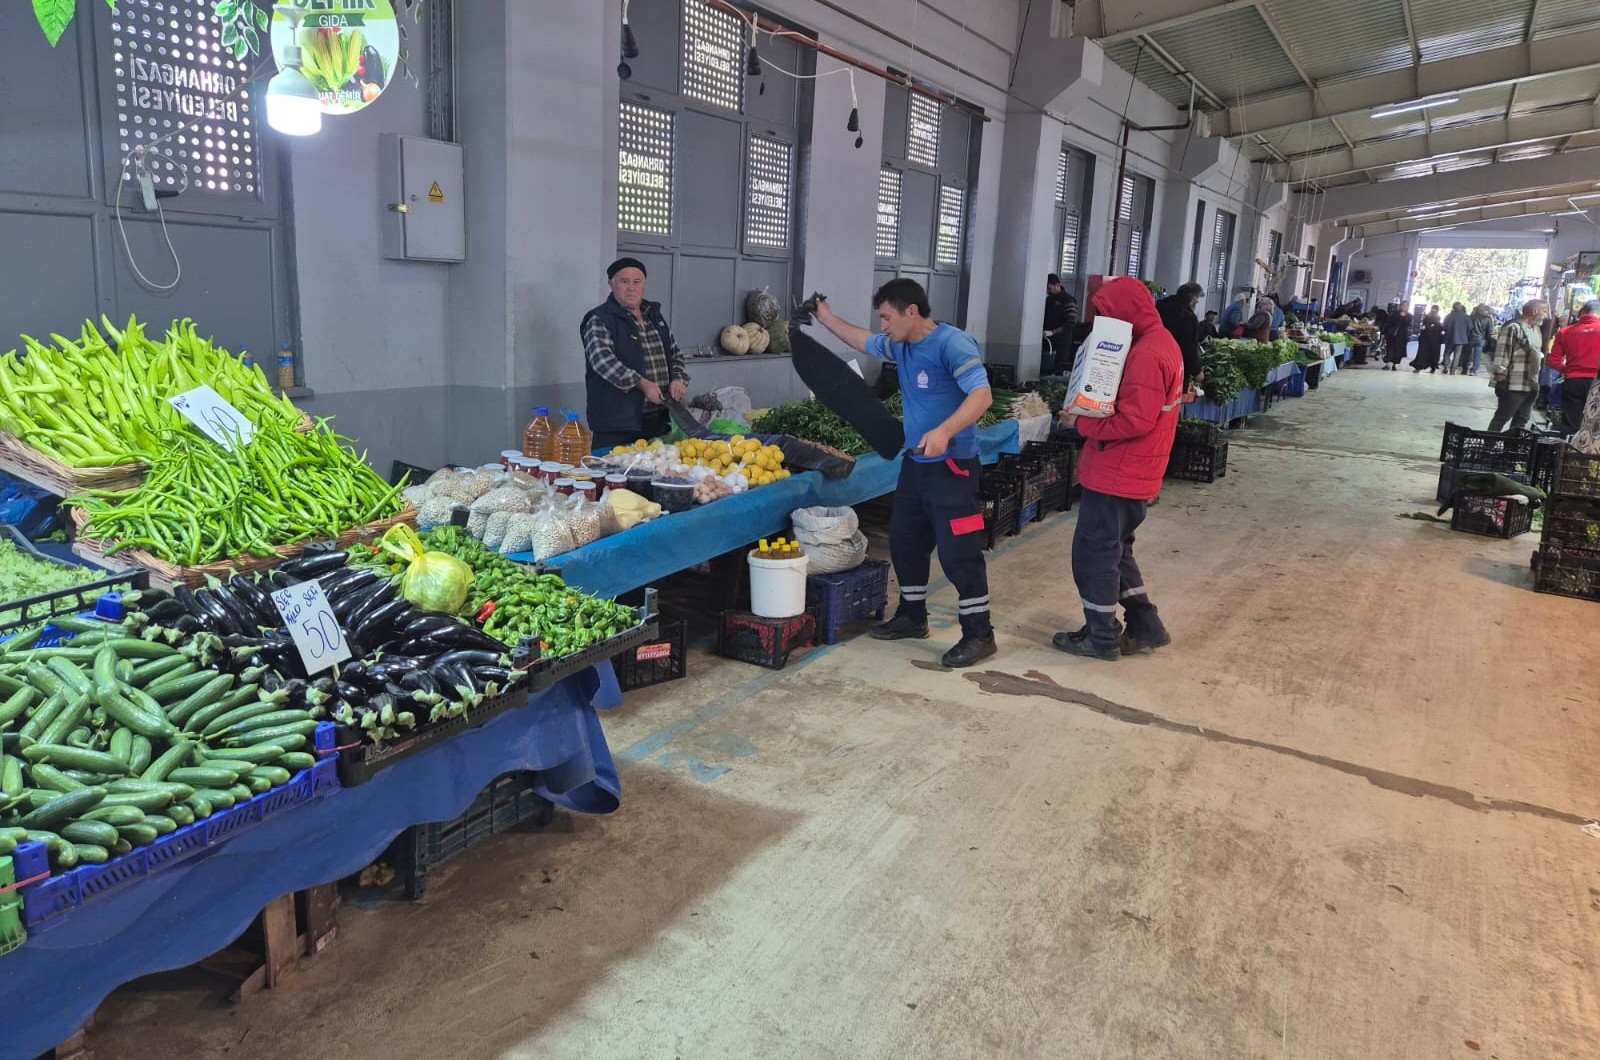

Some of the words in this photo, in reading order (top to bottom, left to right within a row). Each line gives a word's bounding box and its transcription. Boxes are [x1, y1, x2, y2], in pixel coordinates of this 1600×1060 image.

[319, 14, 348, 27] GIDA
[335, 88, 361, 100] DEMİR
[302, 610, 340, 658] 50
